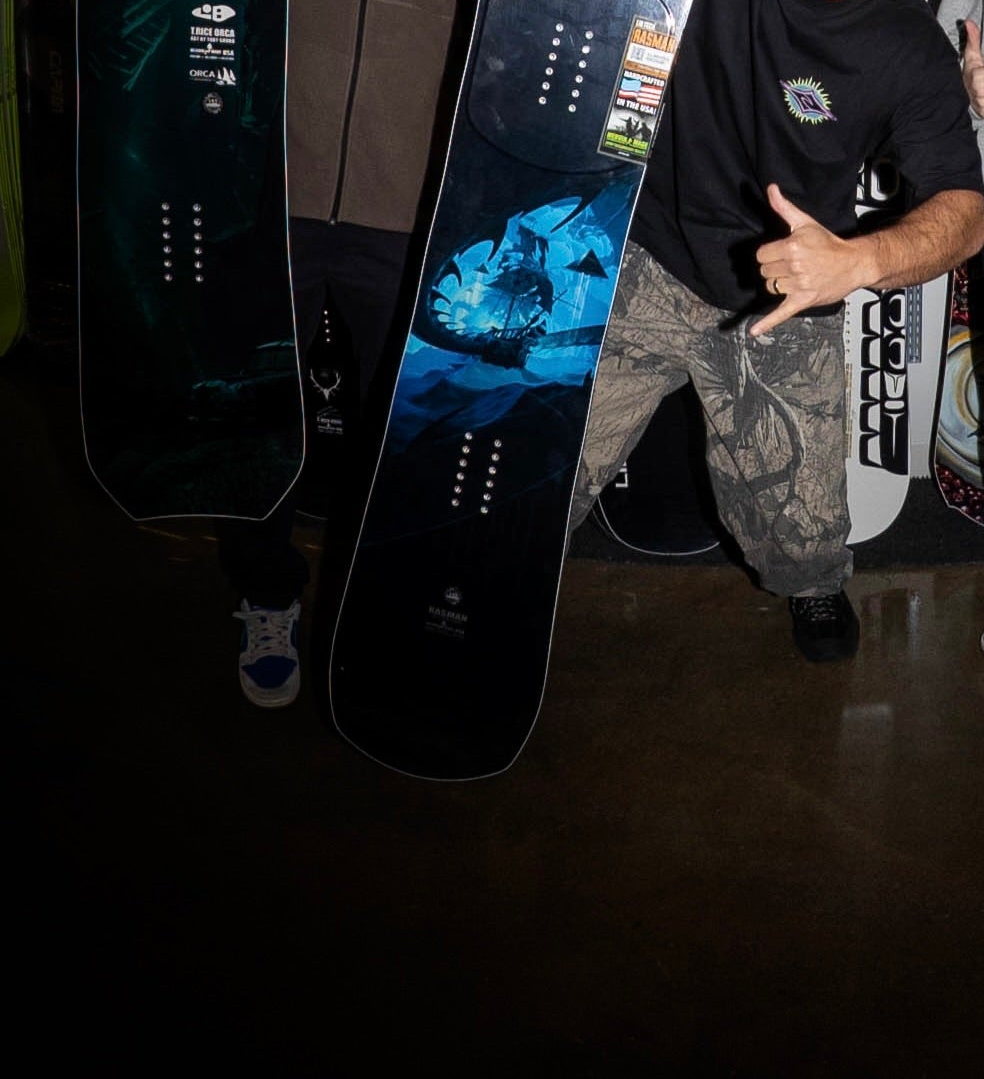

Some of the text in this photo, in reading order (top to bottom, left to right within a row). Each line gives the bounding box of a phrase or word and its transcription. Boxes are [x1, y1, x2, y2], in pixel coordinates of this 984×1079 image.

[190, 26, 236, 38] T.RICE ORCA
[633, 28, 677, 53] RASMAN
[189, 69, 216, 79] ORCA
[624, 70, 665, 87] HANDCRAFTED
[616, 98, 657, 115] IN THE USA!
